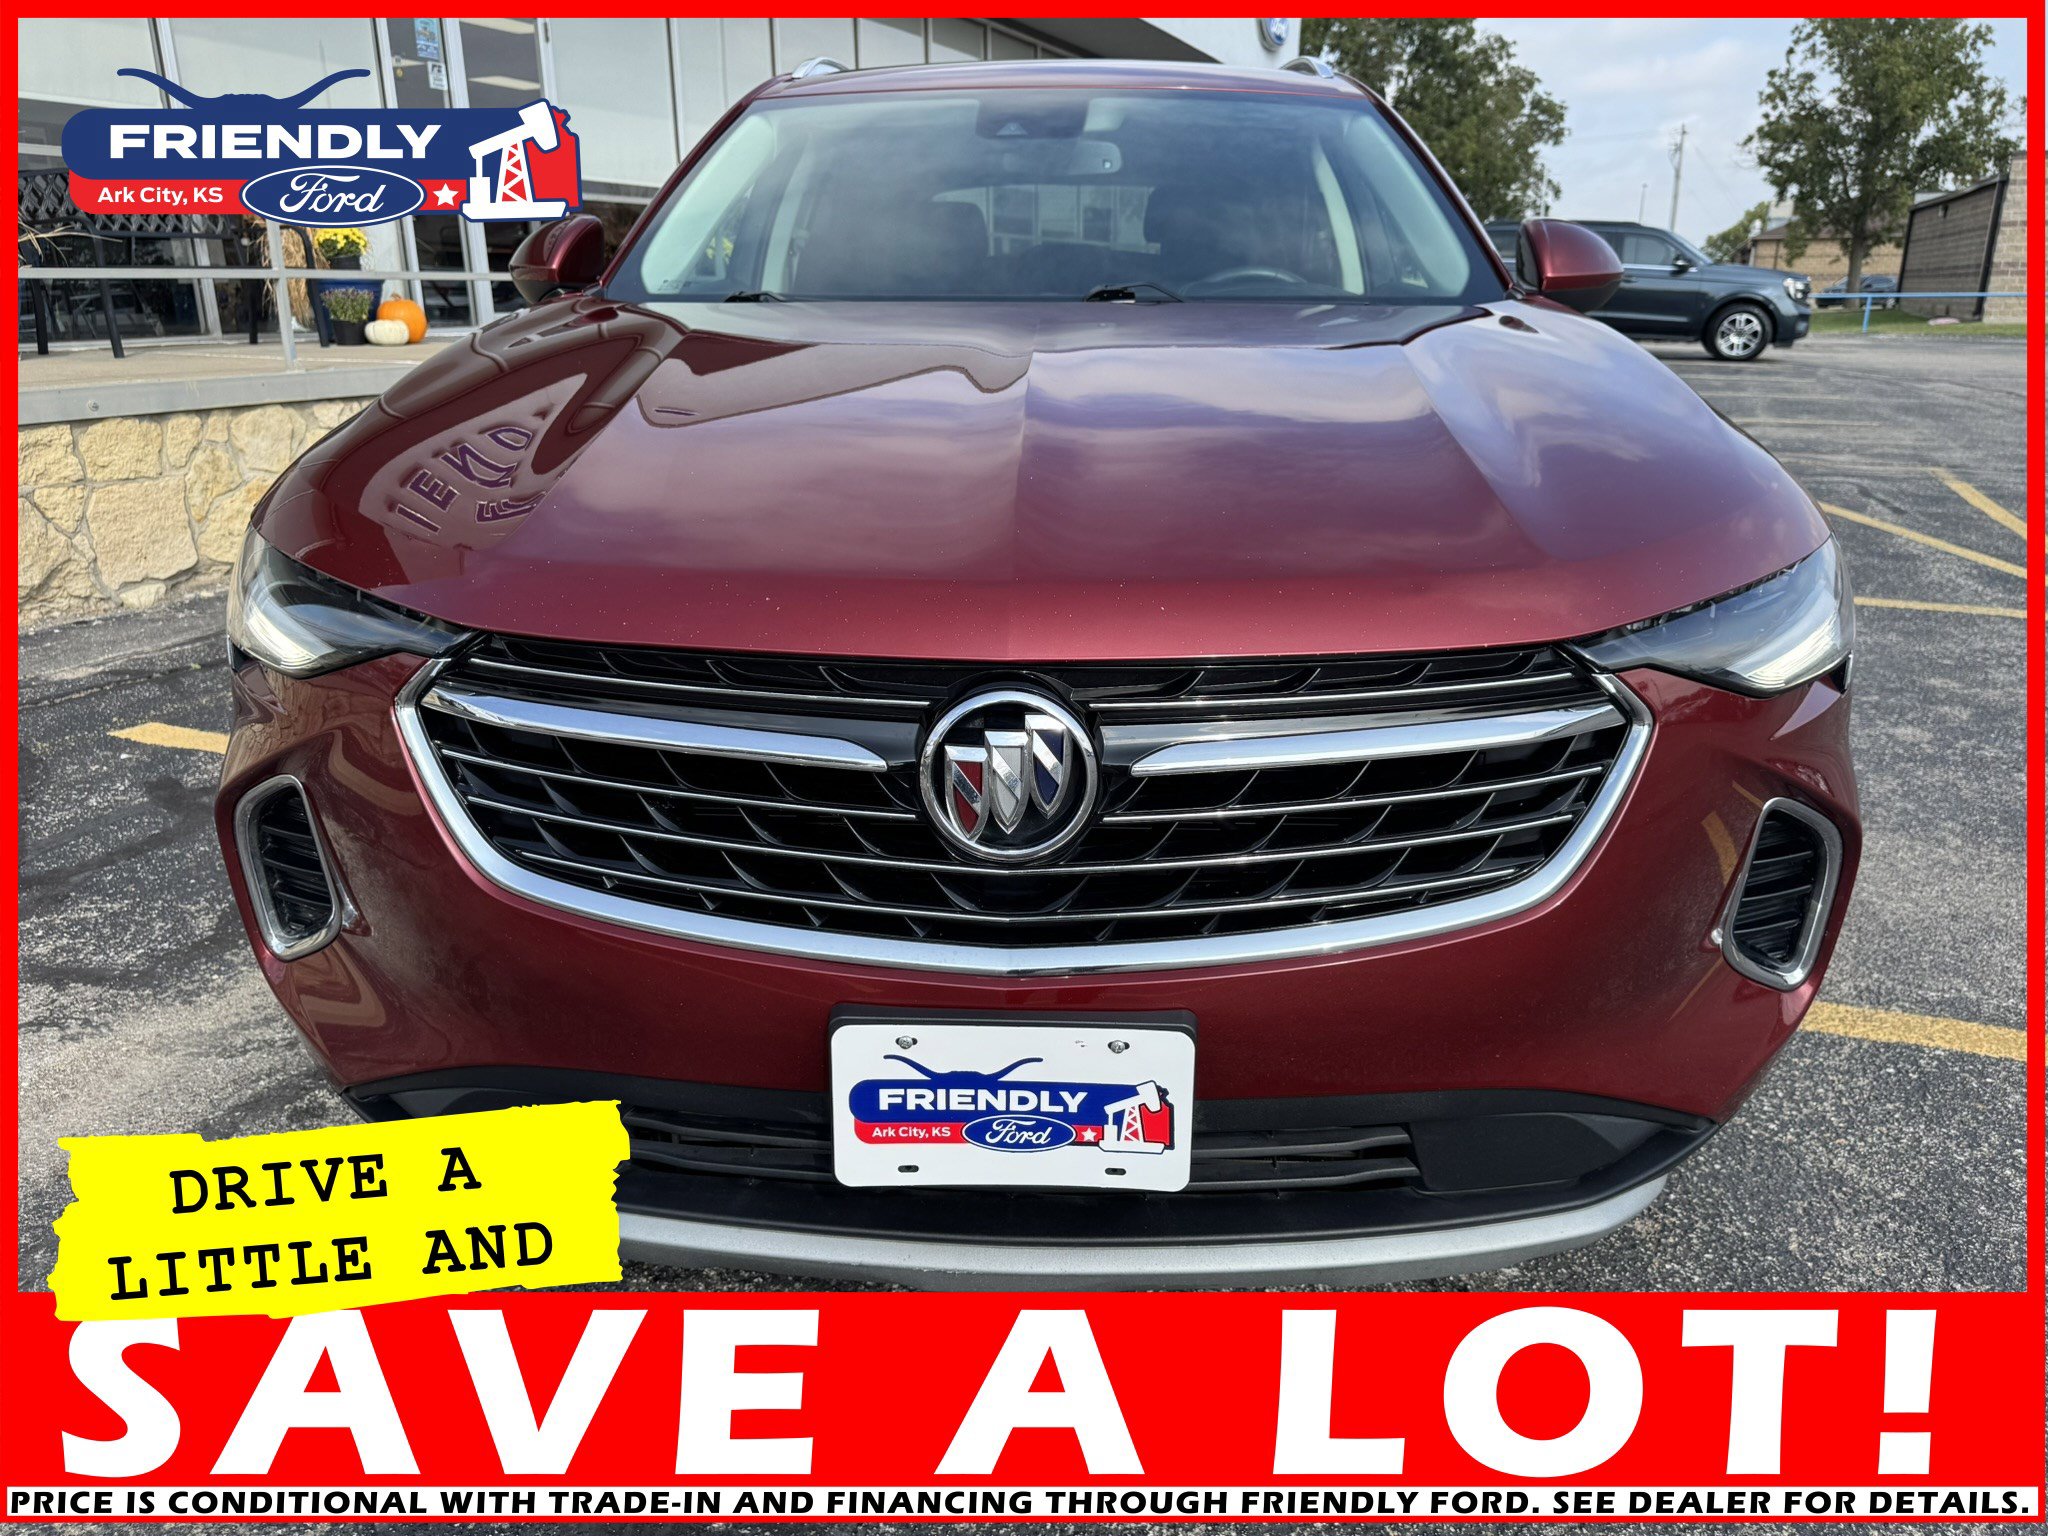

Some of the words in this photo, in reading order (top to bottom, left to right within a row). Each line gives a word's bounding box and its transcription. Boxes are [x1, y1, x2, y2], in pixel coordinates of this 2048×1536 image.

[879, 1088, 1088, 1113] FRIENDLY
[872, 1127, 896, 1138] Ark
[899, 1127, 929, 1139] City,
[932, 1127, 951, 1137] KS
[985, 1119, 1051, 1145] Ford
